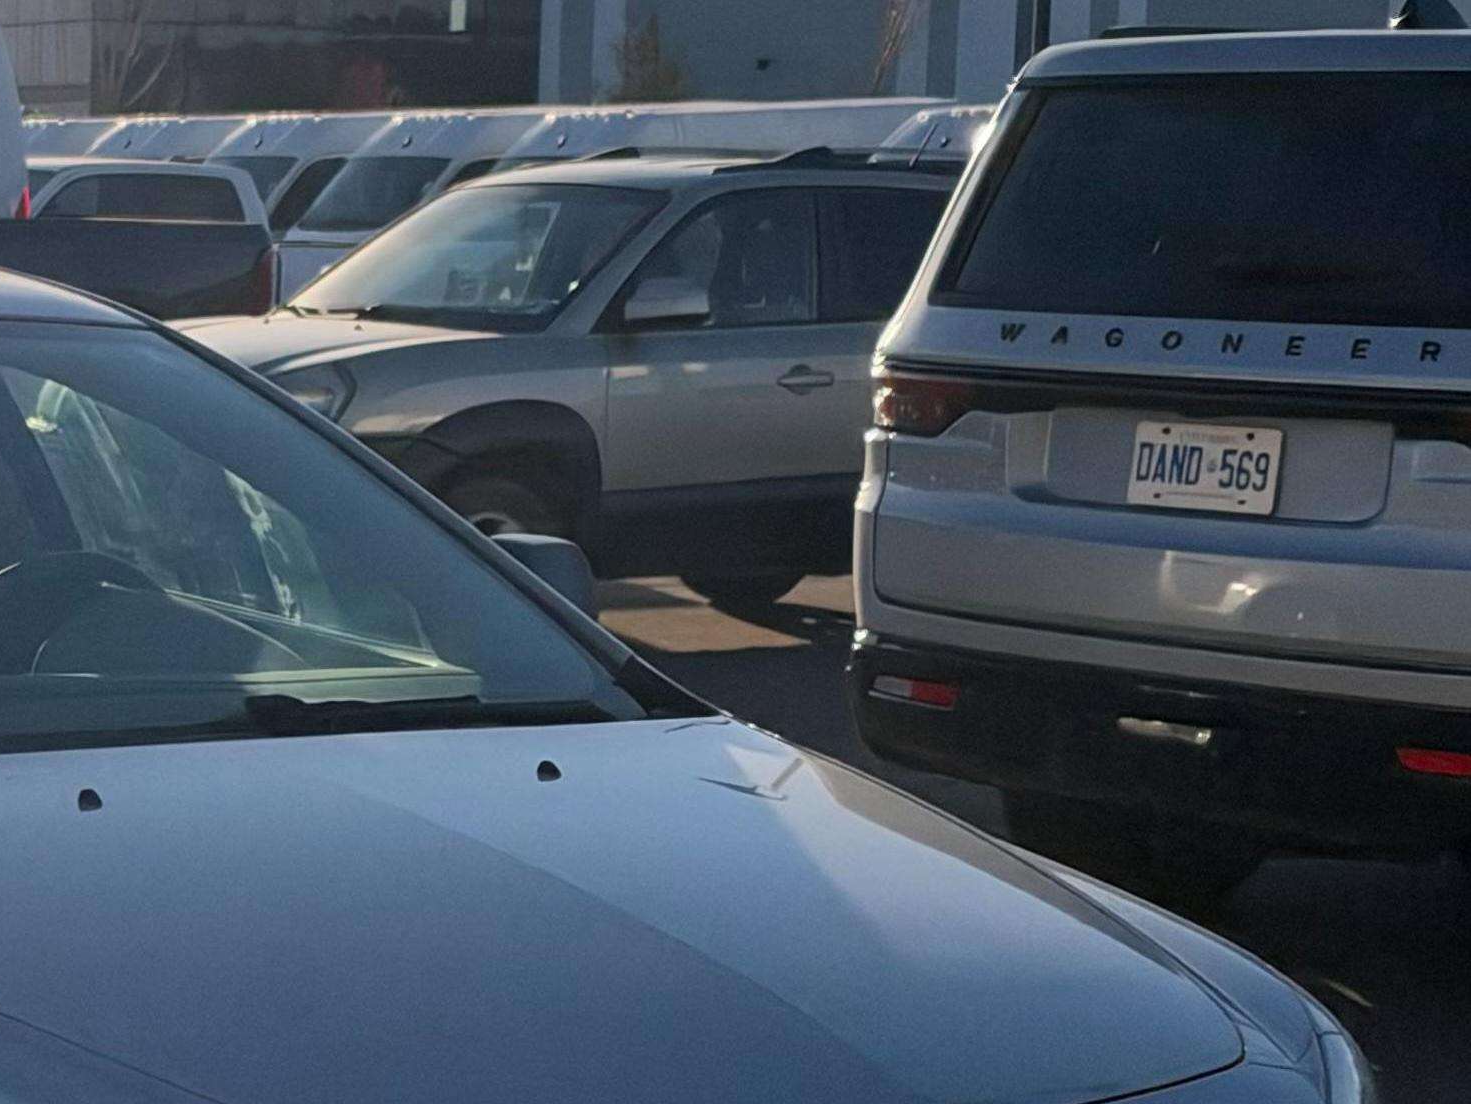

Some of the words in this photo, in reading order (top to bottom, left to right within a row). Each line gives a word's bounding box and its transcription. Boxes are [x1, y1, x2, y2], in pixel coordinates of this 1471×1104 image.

[999, 322, 1442, 362] WAGONEER
[1135, 441, 1204, 486] DAND
[1218, 448, 1271, 492] 569
